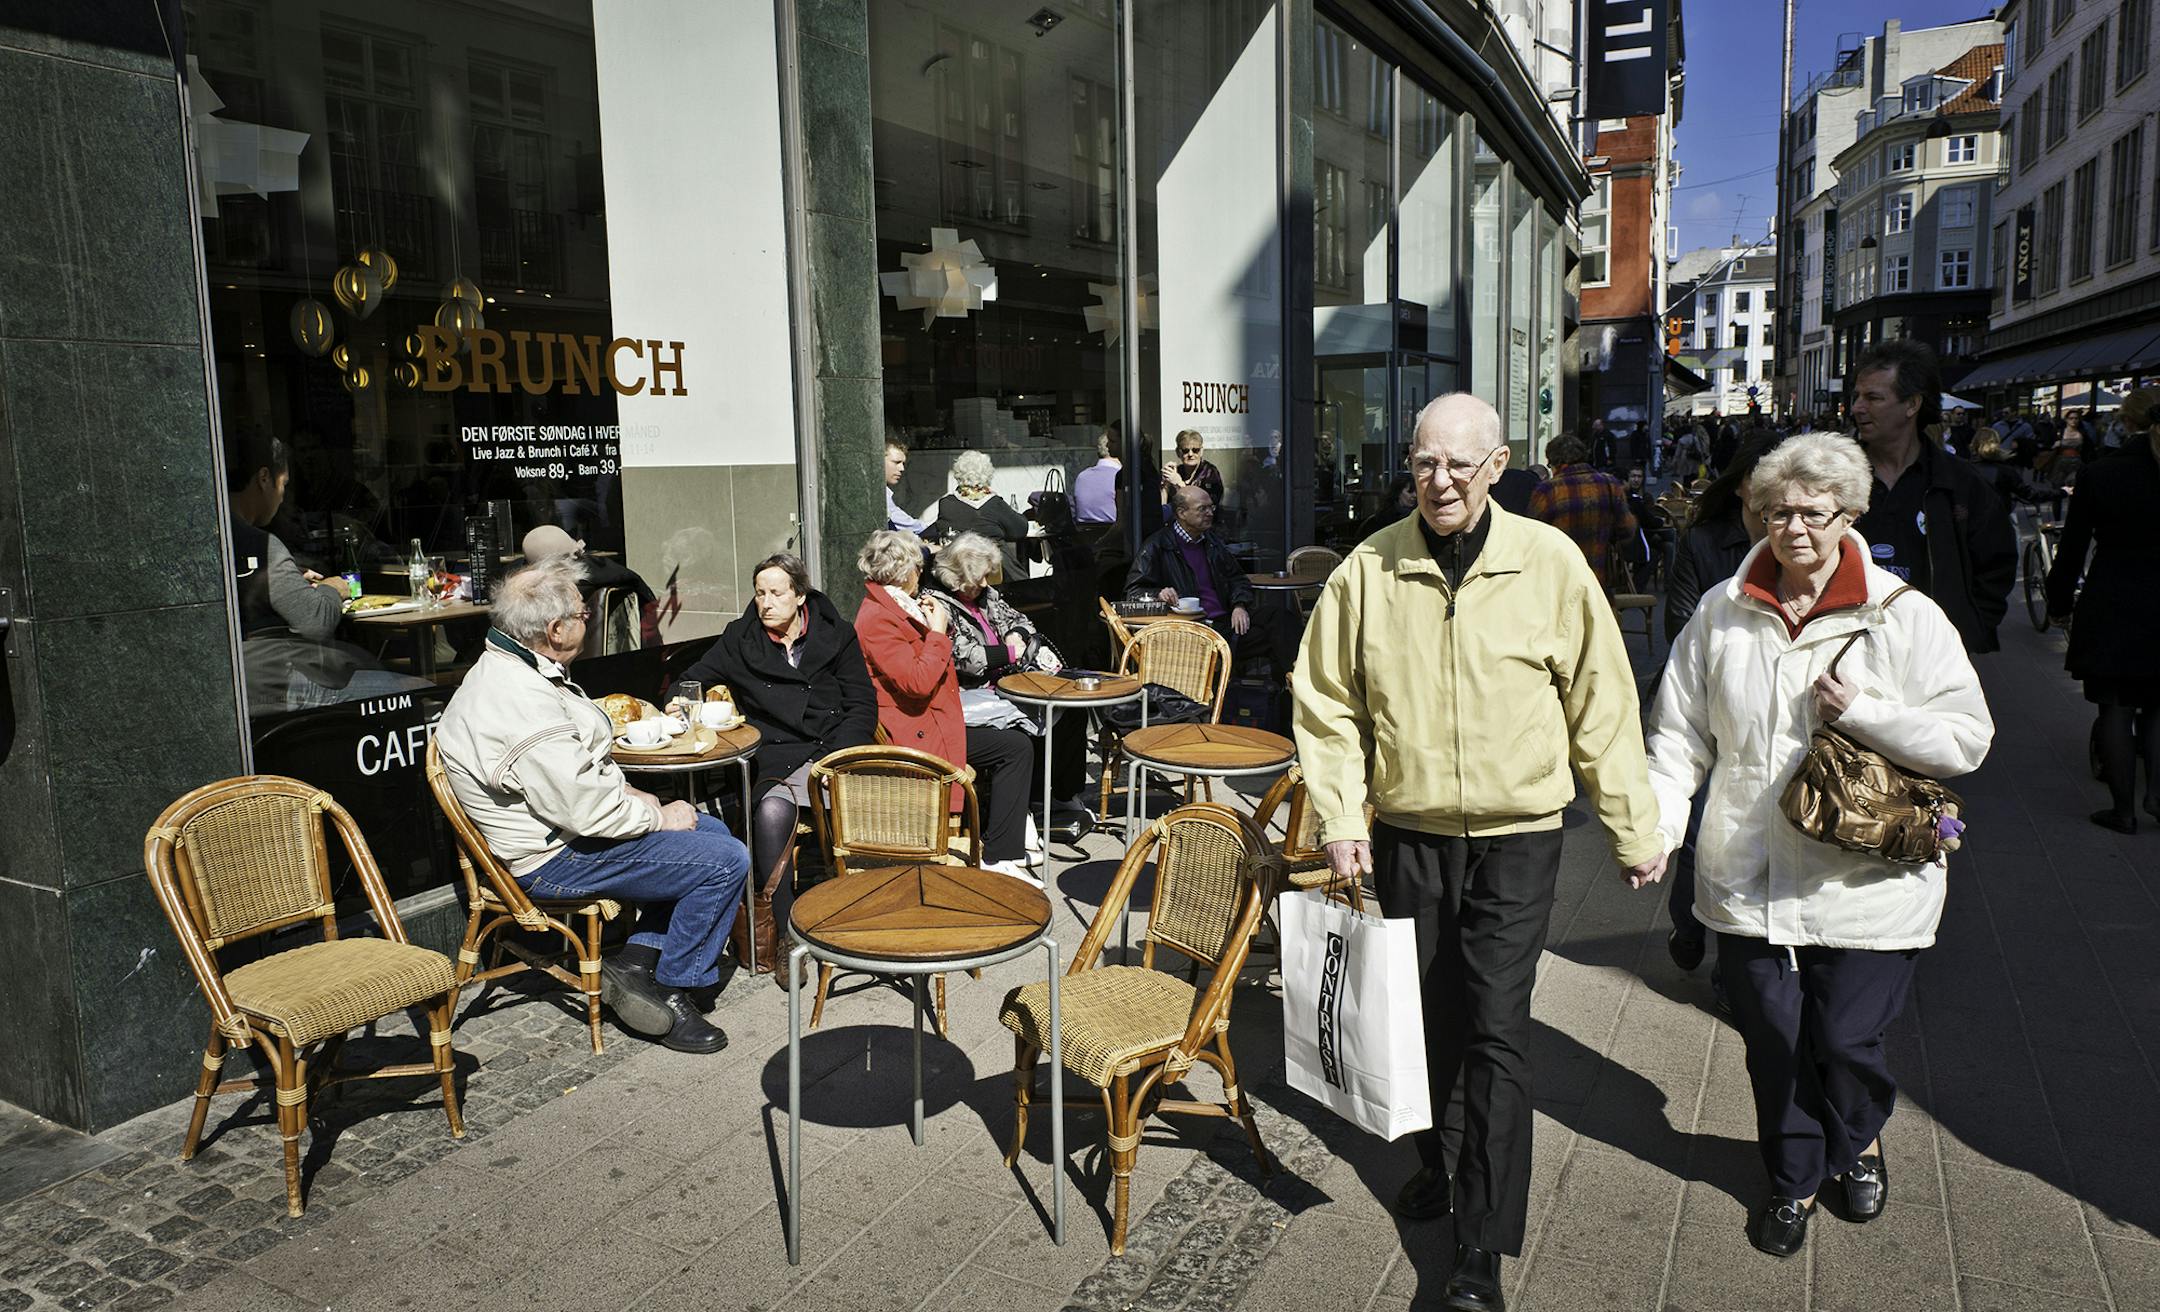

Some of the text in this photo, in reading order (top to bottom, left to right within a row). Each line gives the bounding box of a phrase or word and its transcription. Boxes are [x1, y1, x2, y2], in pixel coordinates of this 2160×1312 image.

[1604, 0, 1652, 62] IL
[1824, 230, 1835, 305] THE BODY SHOP
[2017, 225, 2030, 286] FONA
[418, 325, 688, 396] BRUNCH
[1182, 381, 1249, 414] BRUNCH
[461, 426, 488, 442] DEN
[491, 425, 537, 442] FØRSTE
[539, 425, 586, 441] SØNDAG
[588, 425, 593, 440] I
[595, 425, 621, 440] HVER
[472, 446, 493, 460] Live
[494, 445, 516, 459] Jazz
[517, 445, 526, 459] &
[528, 445, 561, 458] Brunch
[562, 445, 567, 457] i
[569, 444, 591, 457] Café
[591, 444, 599, 456] X
[605, 443, 618, 456] fra
[514, 465, 547, 478] Voksne
[548, 463, 574, 480] 89,-
[578, 464, 599, 475] Barn
[360, 694, 412, 716] ILLUM
[1320, 937, 1341, 1085] CONTRAST
